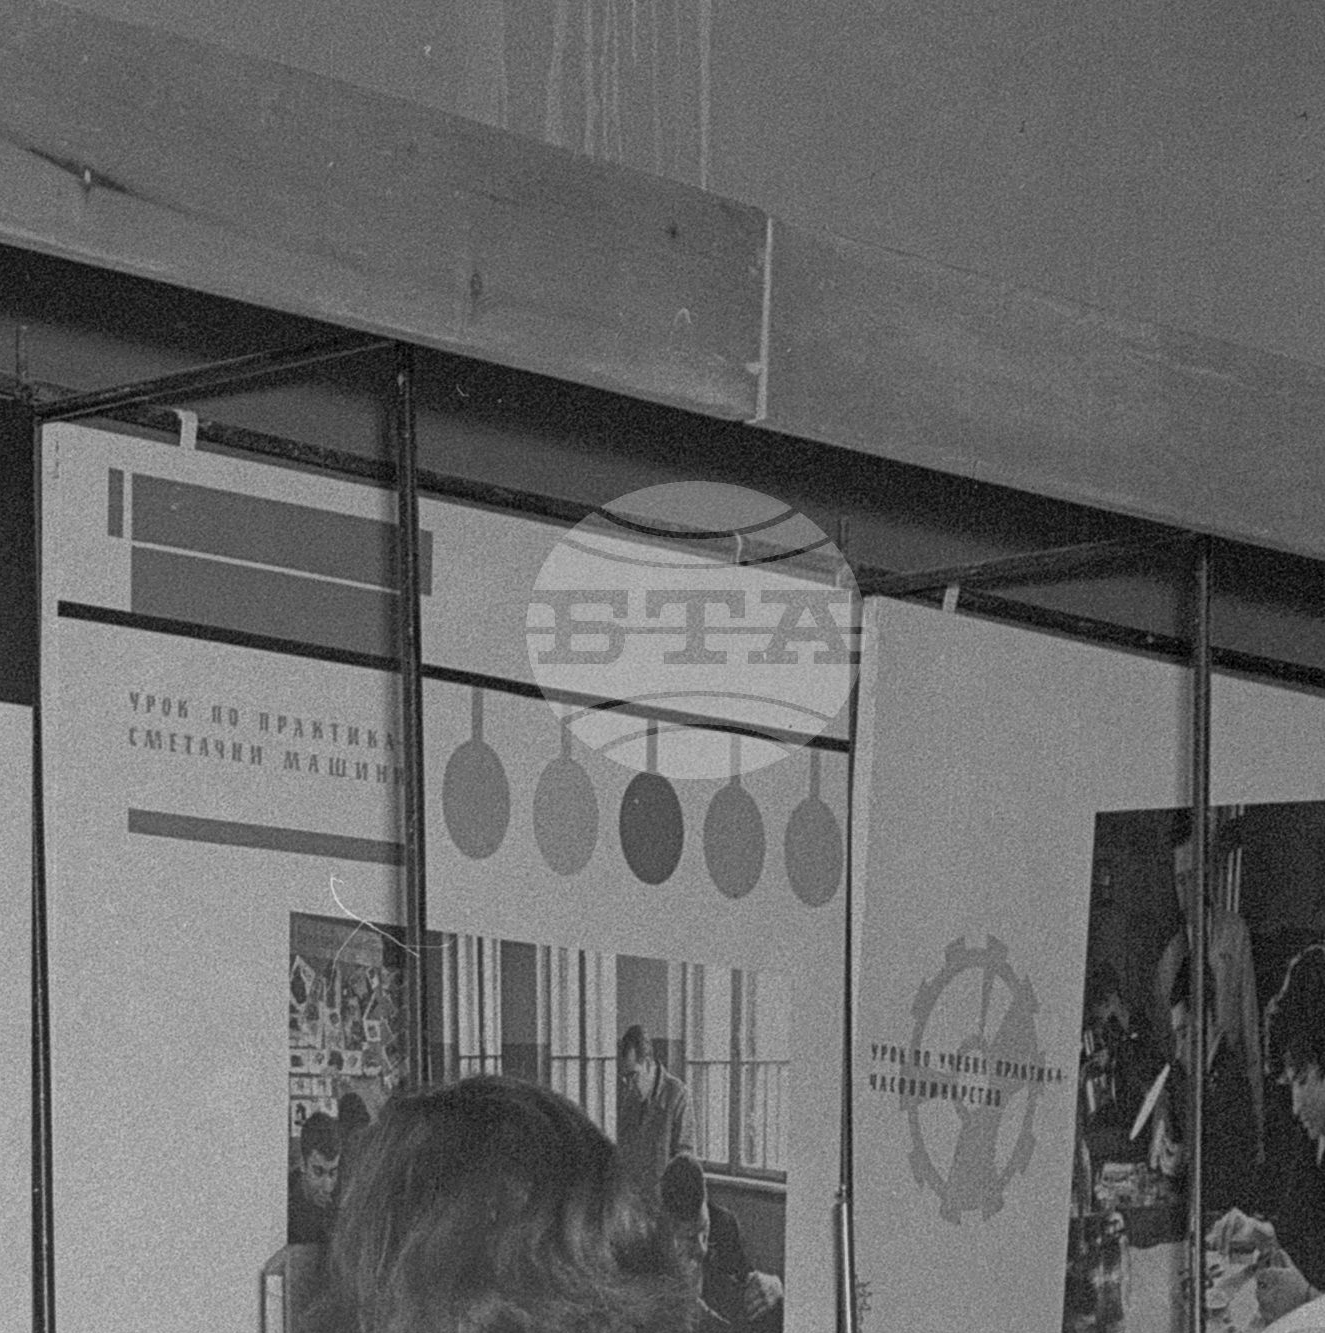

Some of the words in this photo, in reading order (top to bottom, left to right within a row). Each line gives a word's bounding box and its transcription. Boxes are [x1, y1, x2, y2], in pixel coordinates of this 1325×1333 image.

[129, 691, 189, 719] УРОК
[211, 705, 239, 726] ПО
[128, 727, 262, 766] СМЕТАЧНИ
